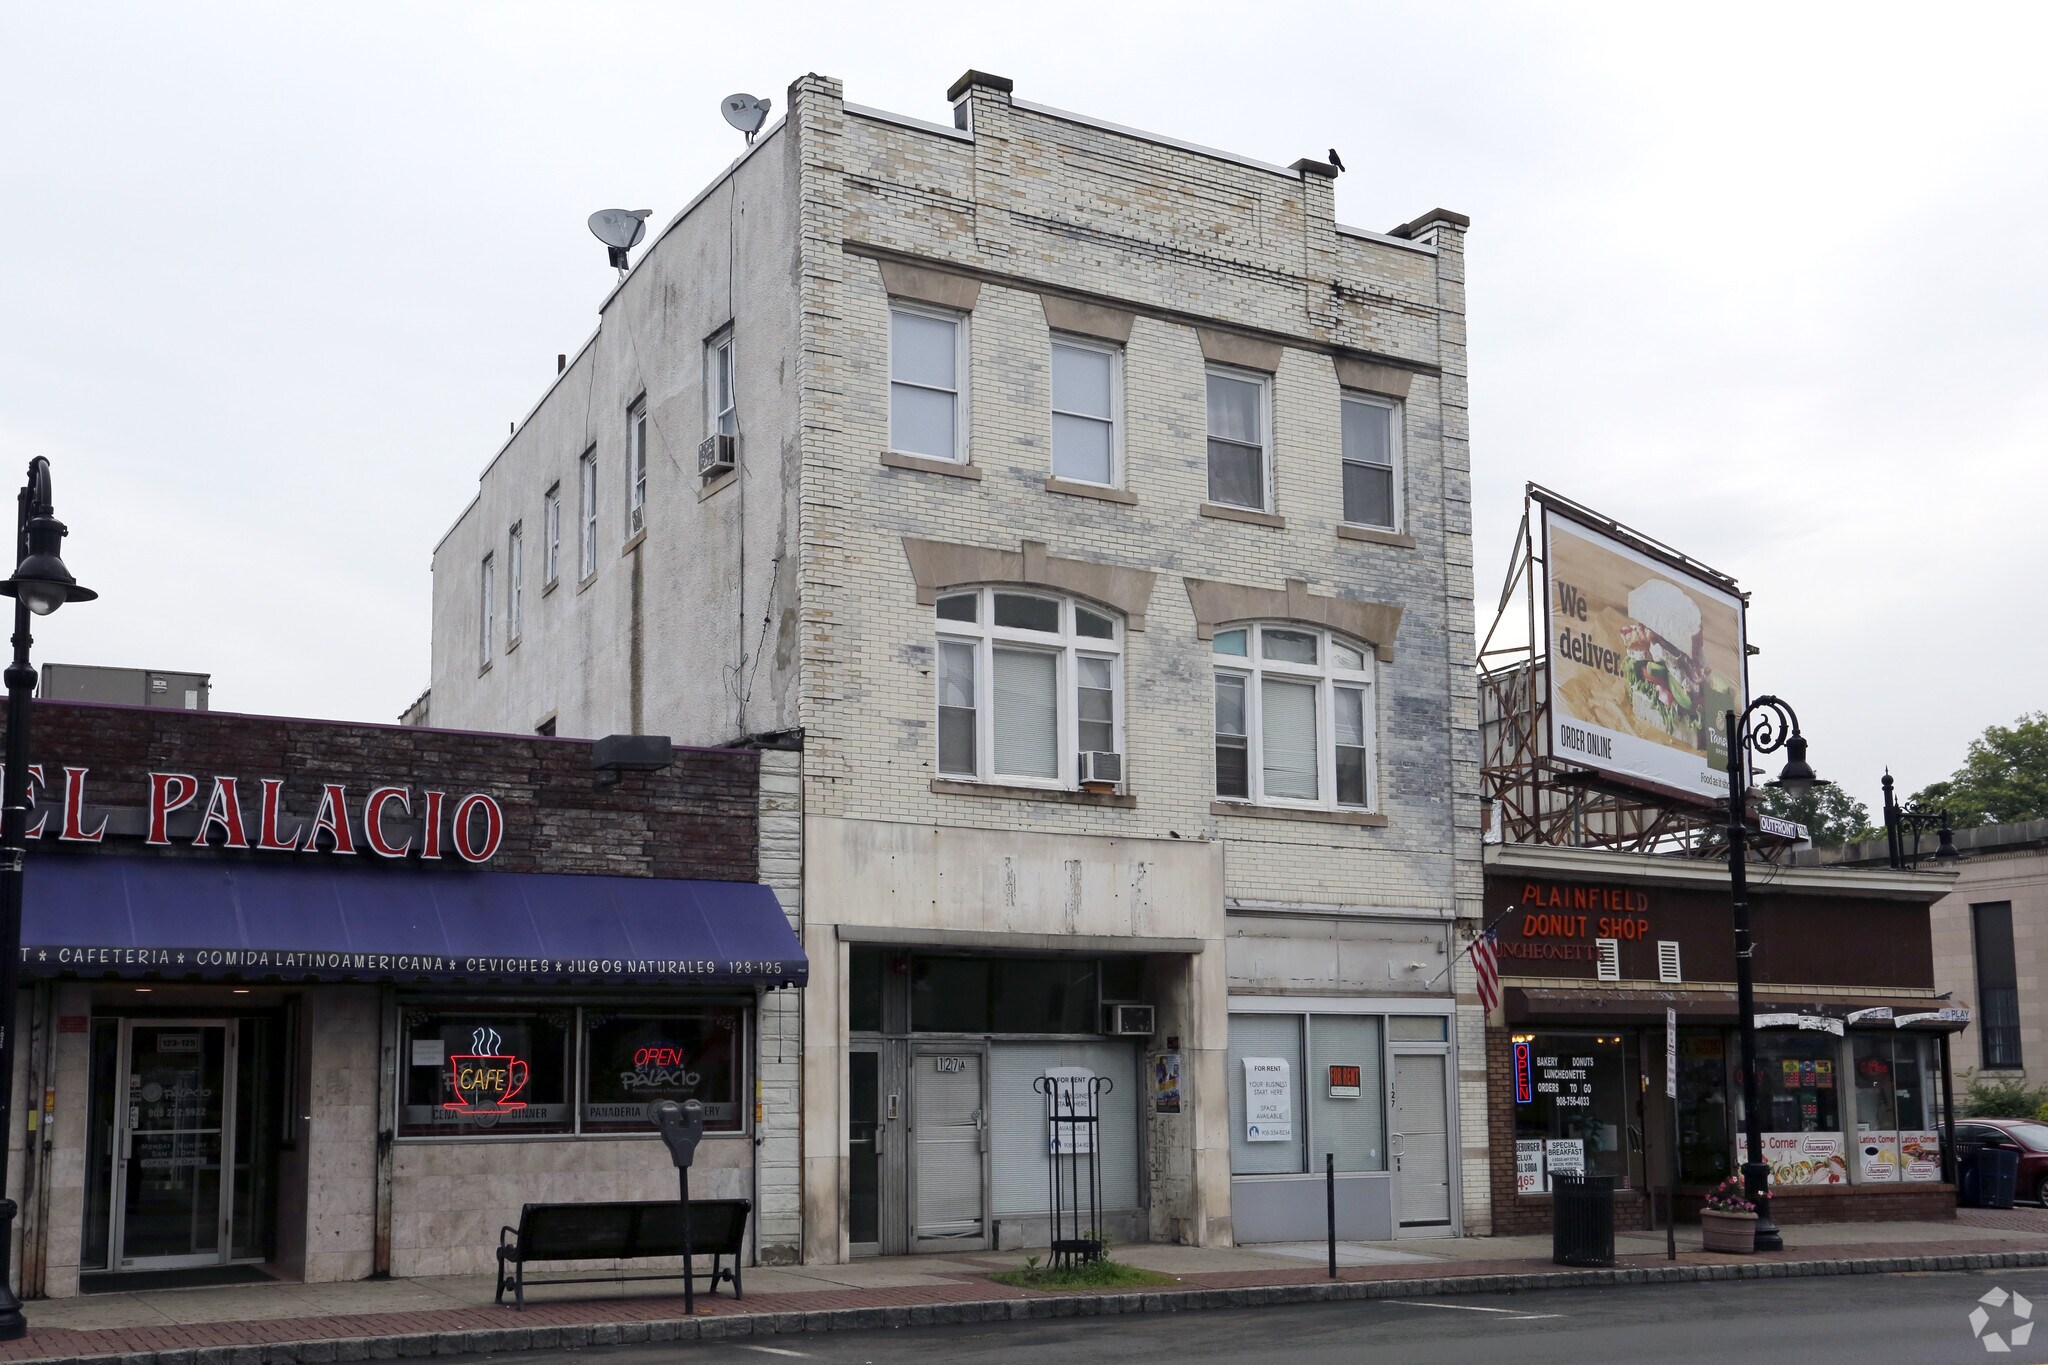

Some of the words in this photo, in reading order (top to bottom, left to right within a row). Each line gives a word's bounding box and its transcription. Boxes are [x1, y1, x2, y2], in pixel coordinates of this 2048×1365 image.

[1558, 580, 1587, 622] We
[1559, 626, 1624, 678] deliver.
[1560, 724, 1585, 752] ORDER
[1587, 732, 1612, 759] ONLINE
[1700, 772, 1712, 785] Food
[145, 772, 504, 864] PALACIO
[1761, 816, 1795, 836] OUTFRONT
[1521, 884, 1648, 912] PLAINFIELD
[1523, 914, 1588, 938] DONUT
[1600, 917, 1649, 941] SHOP
[1497, 942, 1606, 962] UNCHEONETTE
[58, 947, 169, 965] CAFETERIA
[196, 950, 269, 966] COMIDA
[275, 952, 444, 970] LATINOAMERICANA
[466, 957, 550, 973] CEVICHES
[567, 958, 622, 973] JUGOS
[627, 960, 715, 974] NATURALES
[728, 961, 782, 975] 123-125
[1951, 1009, 1969, 1019] PLAY
[163, 1039, 195, 1047] 123-125
[634, 1048, 682, 1066] OPEN
[1536, 1056, 1558, 1067] BAKERY
[1572, 1057, 1594, 1067] DONUTS
[1331, 1067, 1342, 1085] FOR
[1343, 1067, 1360, 1086] RENT
[1516, 1045, 1529, 1100] OPEN
[1543, 1069, 1586, 1080] LUNCHEONETTE
[460, 1068, 506, 1091] CAFE
[1537, 1082, 1559, 1093] ORDERS
[1569, 1083, 1577, 1093] TO
[1583, 1083, 1592, 1093] GO
[432, 1109, 458, 1120] CENA
[511, 1108, 548, 1119] DINNER
[590, 1107, 641, 1118] PANADERIA
[704, 1106, 721, 1117] ERY
[1552, 1141, 1578, 1149] SPECIAL
[1738, 1138, 1766, 1150] Lao
[1769, 1137, 1797, 1149] Corner
[1859, 1136, 1876, 1144] Latino
[1878, 1135, 1896, 1143] Corner
[1901, 1136, 1918, 1144] Latino
[1920, 1135, 1937, 1143] Corner
[141, 1143, 171, 1151] MONDAY
[1548, 1148, 1583, 1156] BREAKFAST
[1524, 1162, 1538, 1173] SODA
